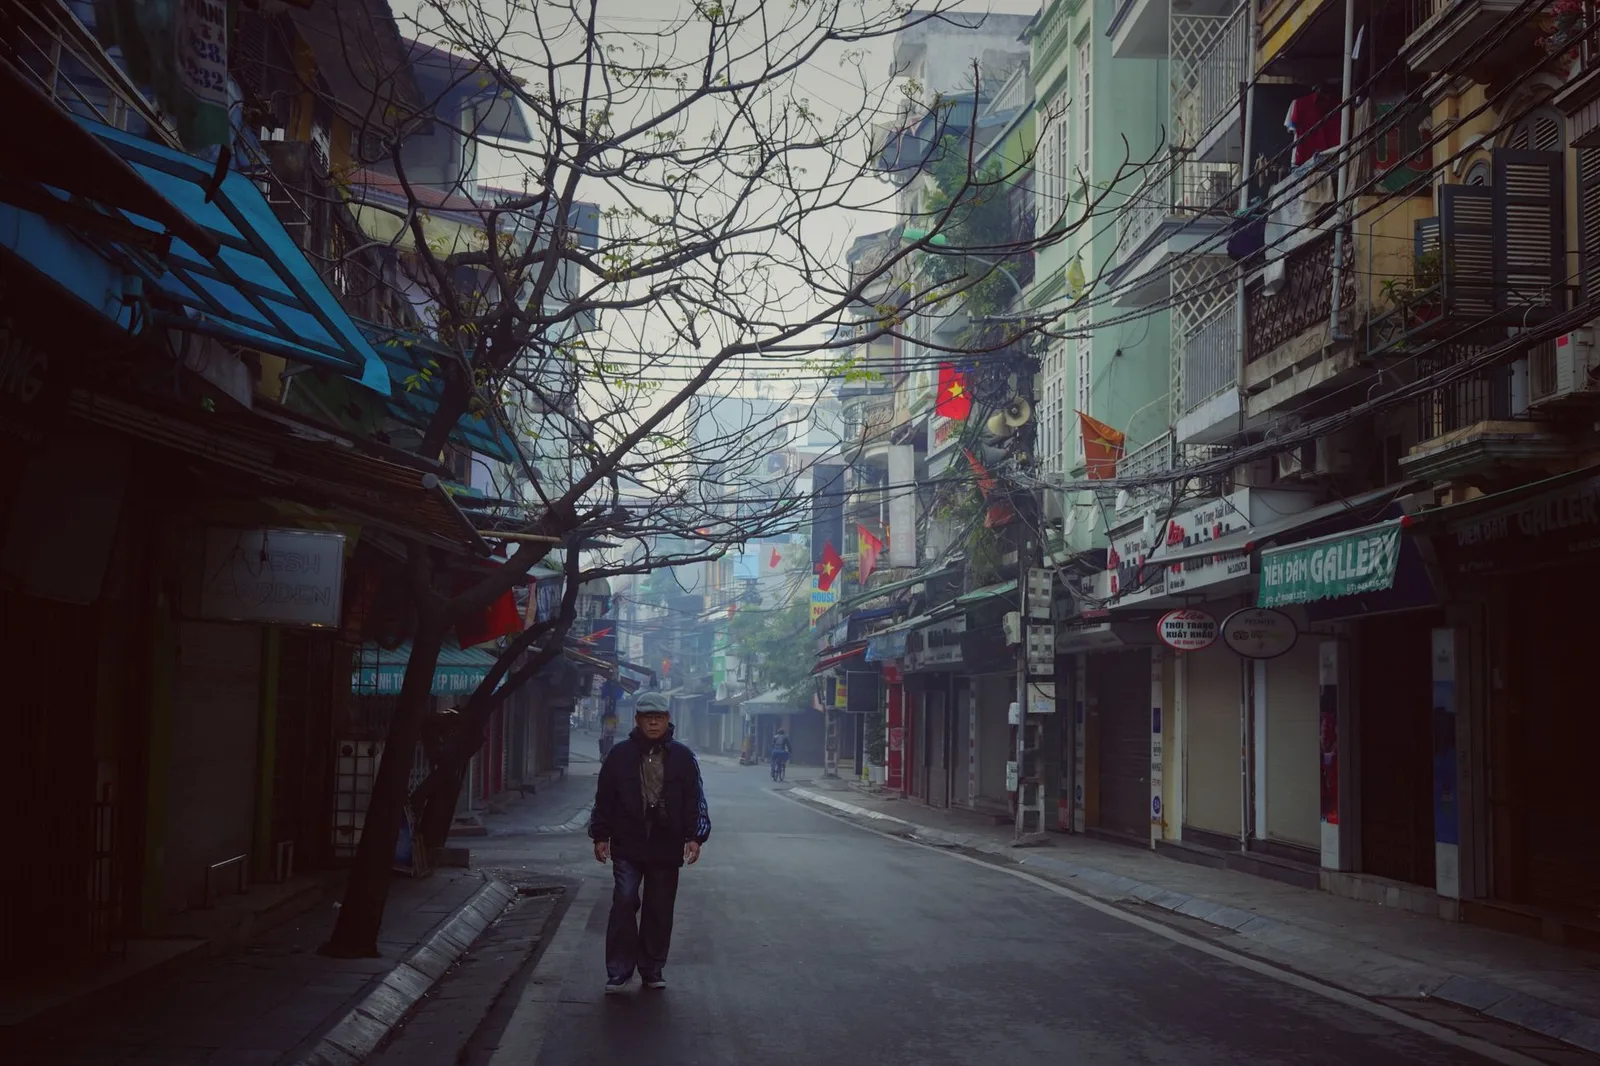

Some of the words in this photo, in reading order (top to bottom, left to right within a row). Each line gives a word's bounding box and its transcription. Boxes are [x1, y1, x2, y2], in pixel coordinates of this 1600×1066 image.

[1517, 488, 1600, 537] GALLER
[1311, 531, 1397, 584] GALLERY
[1187, 621, 1215, 630] TRANG
